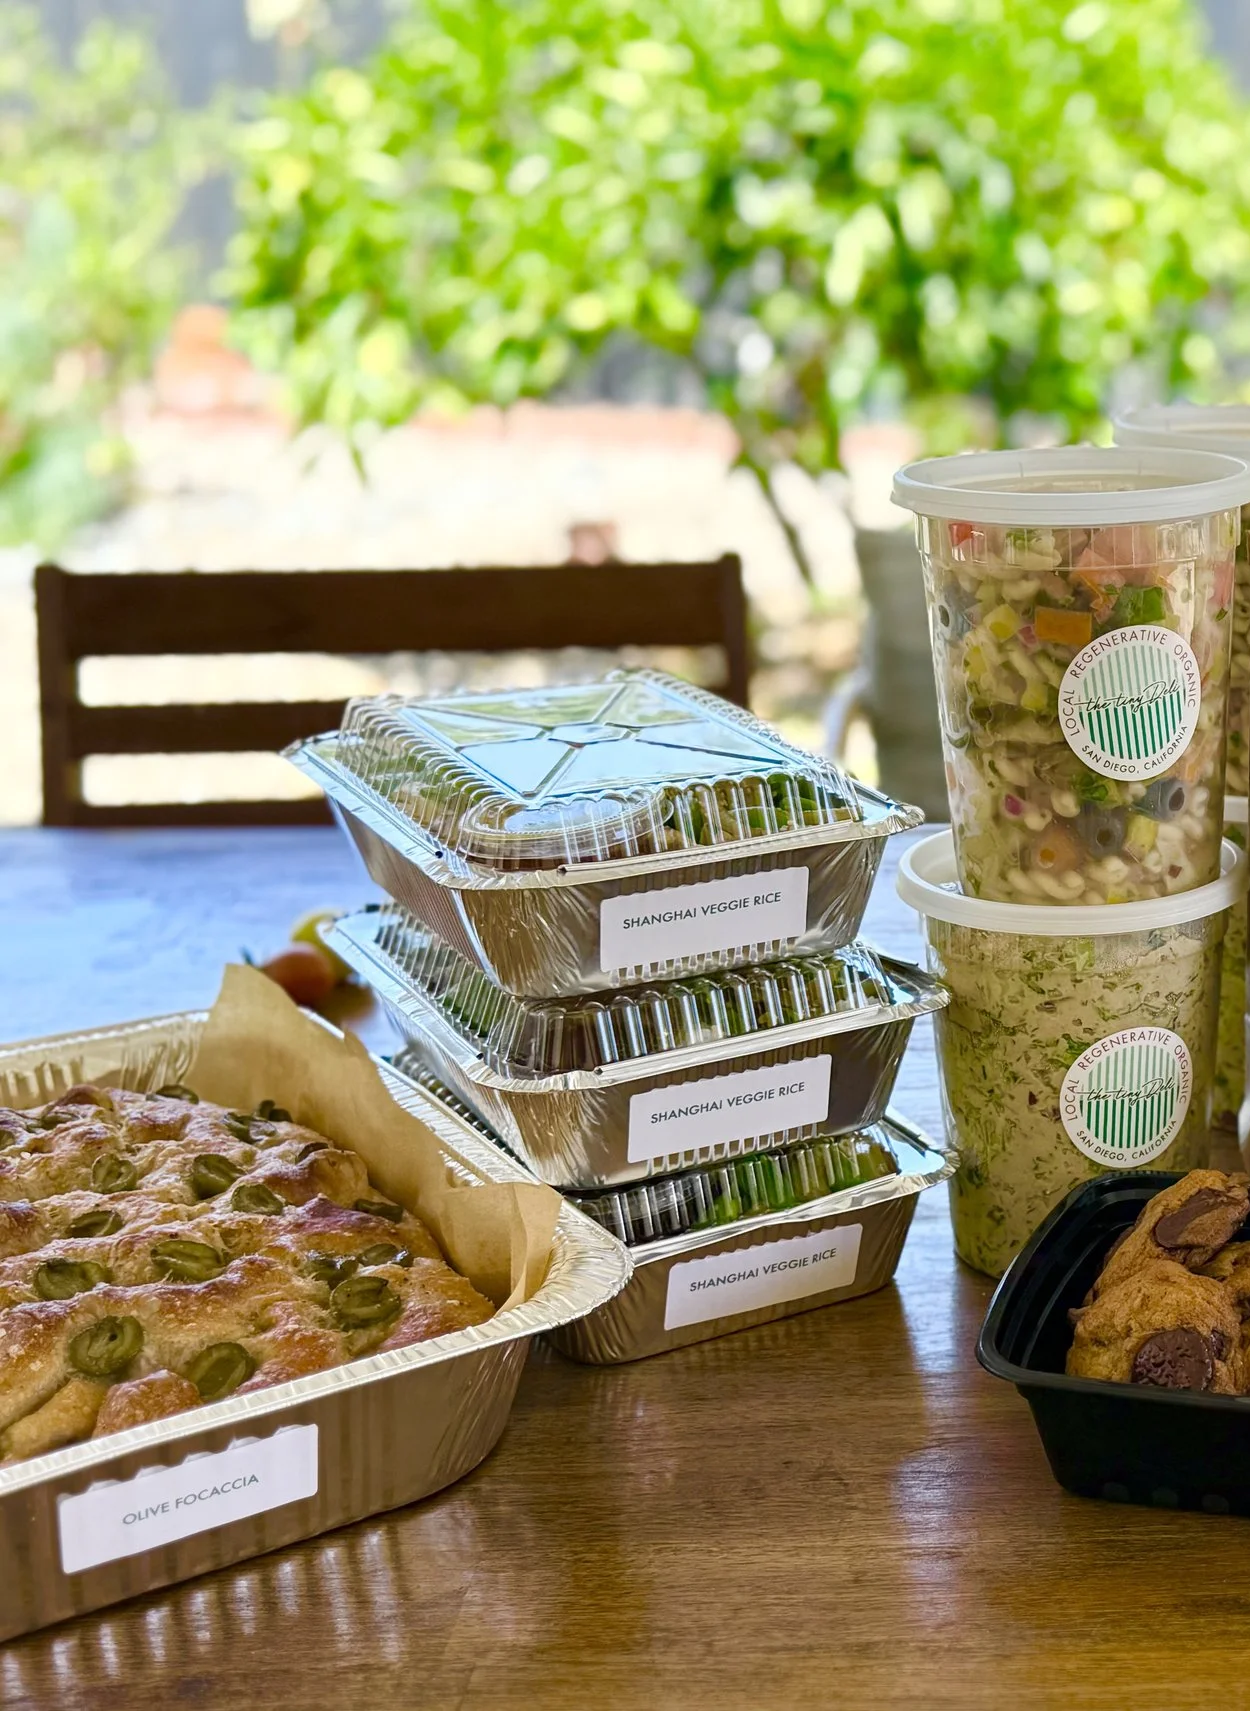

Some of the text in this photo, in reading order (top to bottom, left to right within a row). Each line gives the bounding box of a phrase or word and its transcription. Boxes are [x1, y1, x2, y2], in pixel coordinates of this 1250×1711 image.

[1063, 629, 1196, 737] LOCAL REGENERATIVE ORGANIC
[1082, 745, 1101, 763] SAN
[1144, 725, 1187, 772] CALIFORNIA
[623, 891, 782, 930] SHANGHAI VEGGIE RICE
[1064, 1030, 1191, 1121] LOCAL REGENERATIVE ORGANIC
[650, 1081, 806, 1124] SHANGHAI VEGGIE RICE
[1077, 1119, 1177, 1162] SAN DIEGO, CALIFORNIA
[689, 1248, 837, 1292] SHANGHAI VEGGIE RICE
[122, 1474, 259, 1525] OLIVE FOCACCIA
